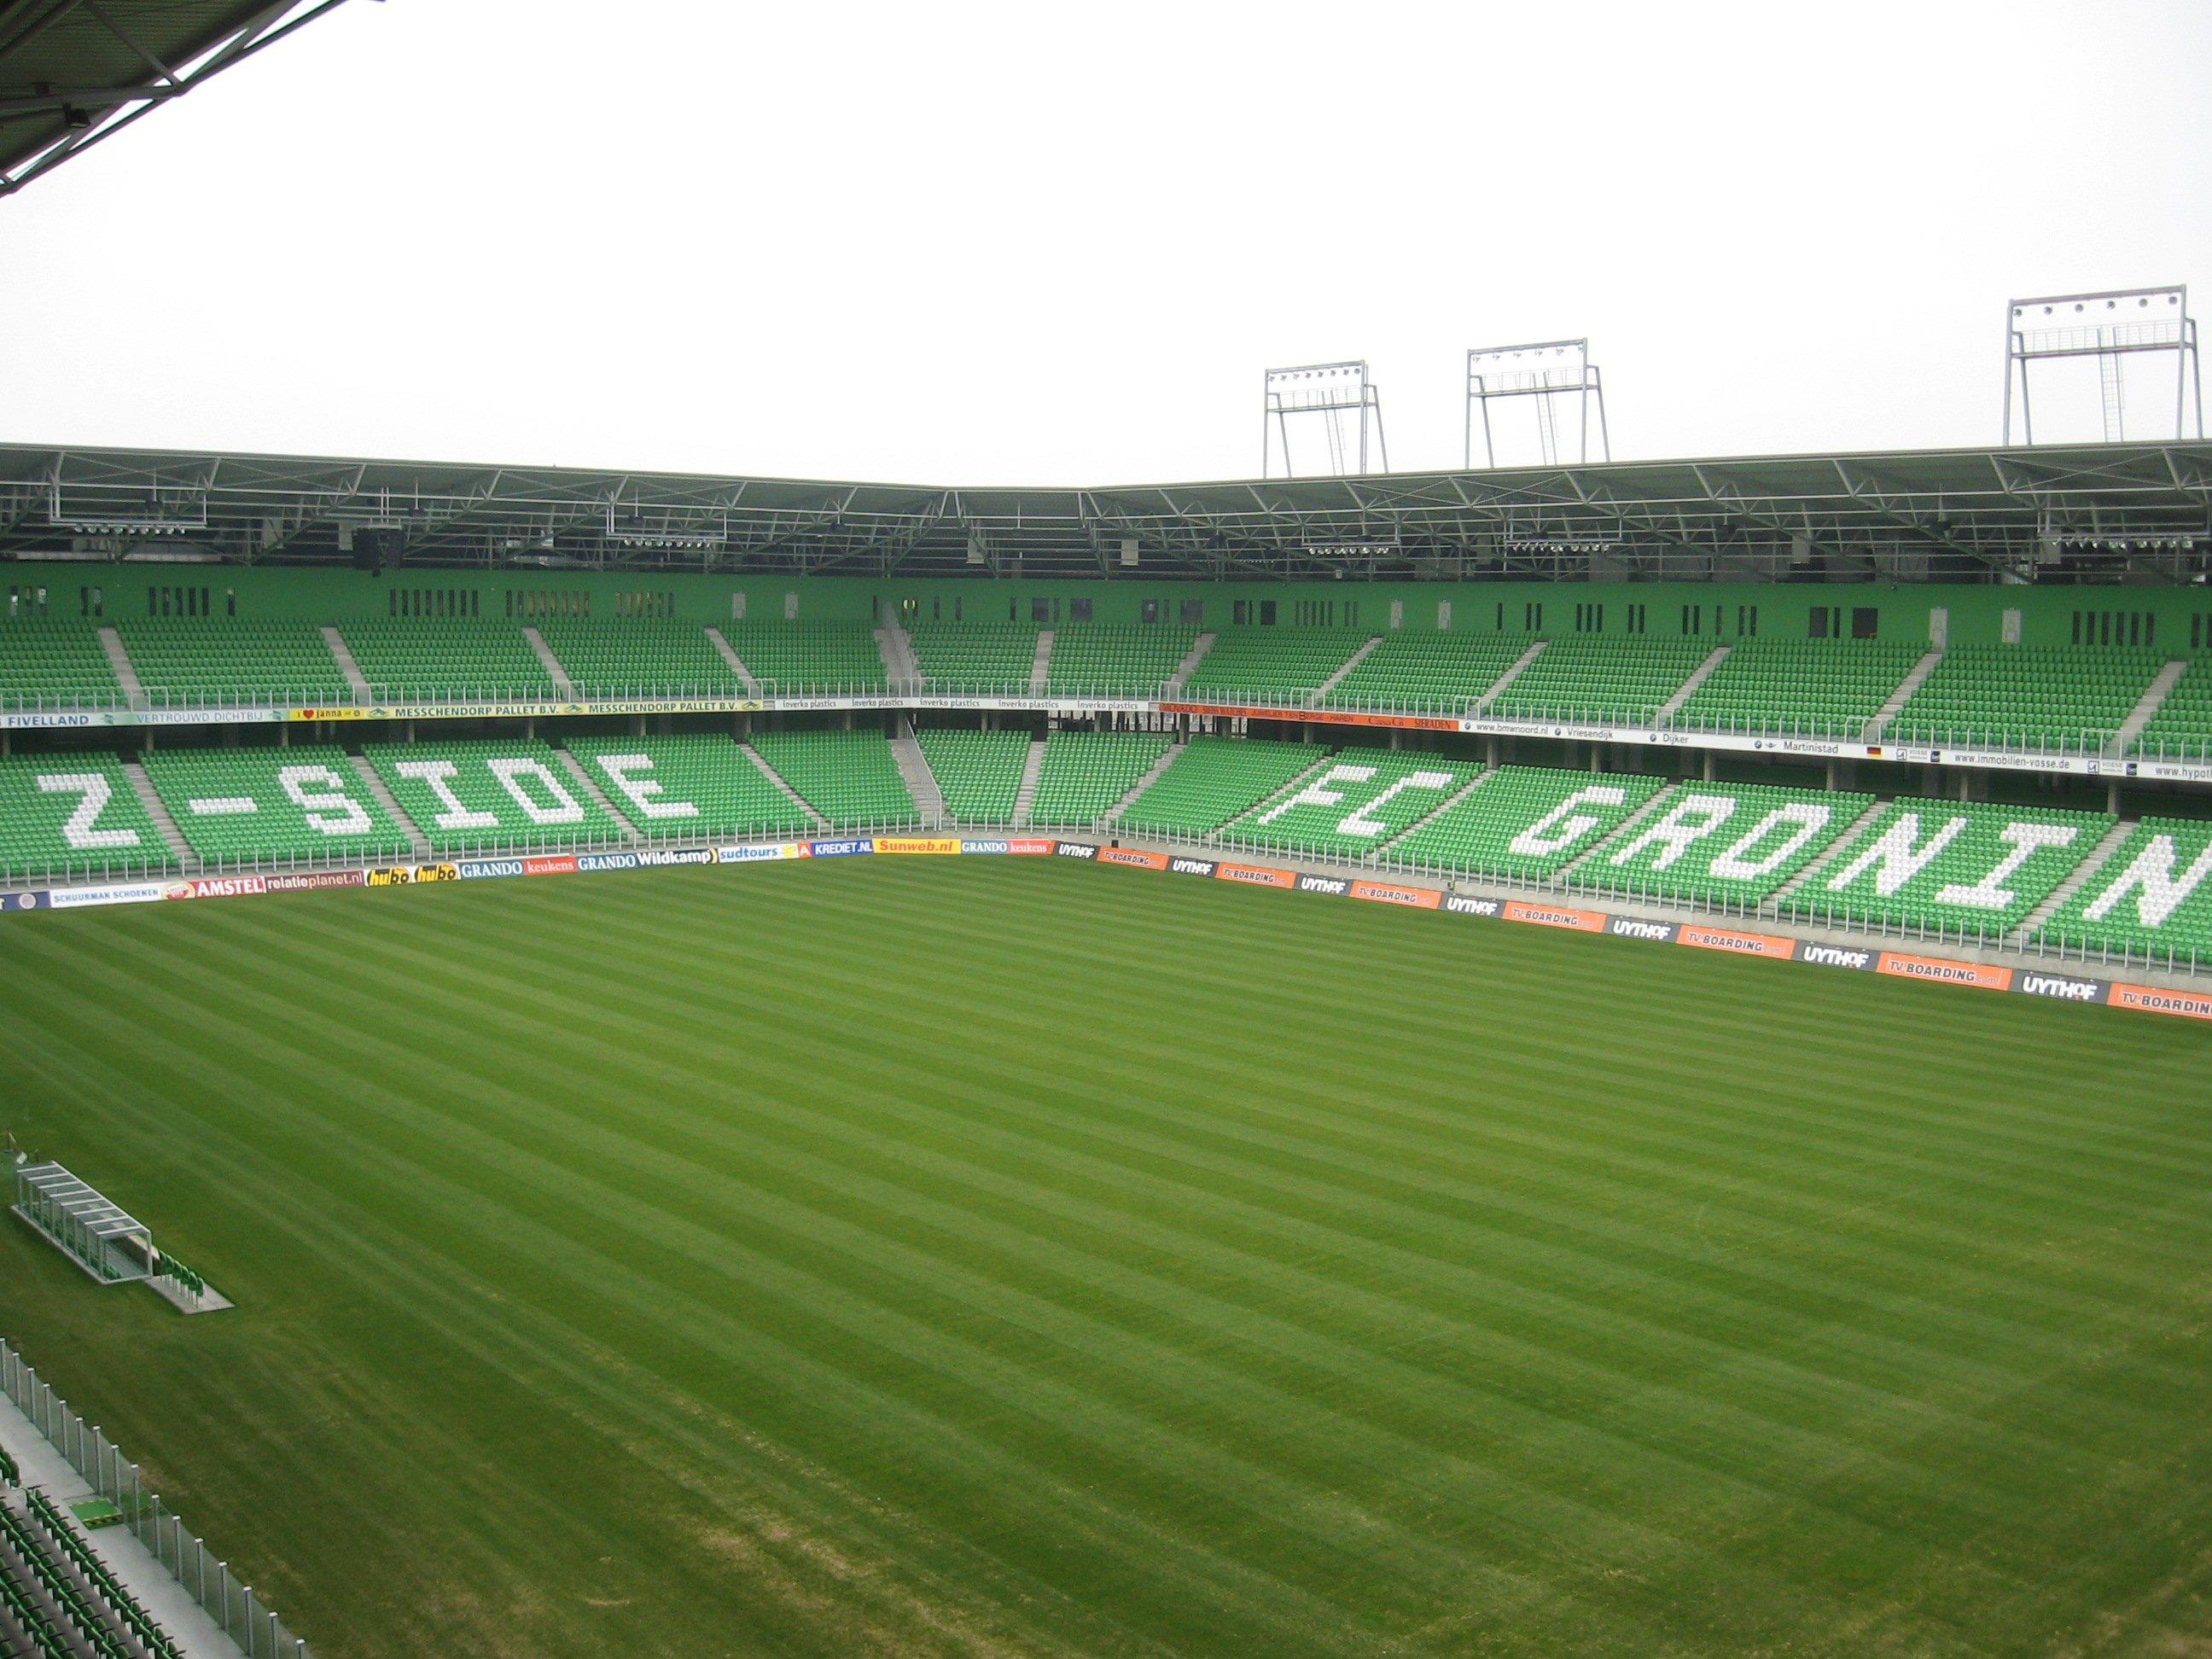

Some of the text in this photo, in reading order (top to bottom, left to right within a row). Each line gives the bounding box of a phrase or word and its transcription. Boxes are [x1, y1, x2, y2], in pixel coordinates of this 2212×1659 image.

[589, 702, 676, 713] MESSCHENDORP
[682, 702, 716, 711] PALLET
[810, 700, 836, 708] plastics
[878, 699, 904, 707] plastics
[951, 698, 981, 708] plastics
[1029, 699, 1059, 708] plastics
[1109, 701, 1138, 710] plastics
[137, 713, 210, 724] VERTROUWD
[395, 706, 559, 717] MESSCHENDORP PALLET B.V.
[9, 715, 90, 726] FIVELLAND
[1784, 741, 1839, 754] Martinistad
[1954, 753, 2070, 769] www.immobilien-vosse.de
[719, 846, 778, 859] sudtours
[880, 840, 952, 852] Sunweb.nl
[962, 841, 1047, 853] GRANDO keukens
[1058, 843, 1095, 859] UYTHOF
[578, 854, 636, 870] GRANDO
[638, 850, 711, 866] Wildkamp
[417, 864, 457, 882] hubo
[462, 858, 574, 877] GRANDO keukens
[1173, 859, 1213, 875] UYTHOF
[267, 871, 363, 889] relatieplanet.nl
[370, 868, 410, 886] hubo
[1301, 876, 1347, 894] UYTHOF
[195, 877, 264, 896] AMSTEL
[55, 891, 110, 903] SCHUURMAN
[114, 888, 159, 899] SCHOENEN
[1447, 897, 1498, 916] UYTHOF
[1613, 920, 1671, 940] UYTHOF
[1803, 946, 1870, 968] UYTHOF
[2023, 975, 2098, 1000] UYTHOF
